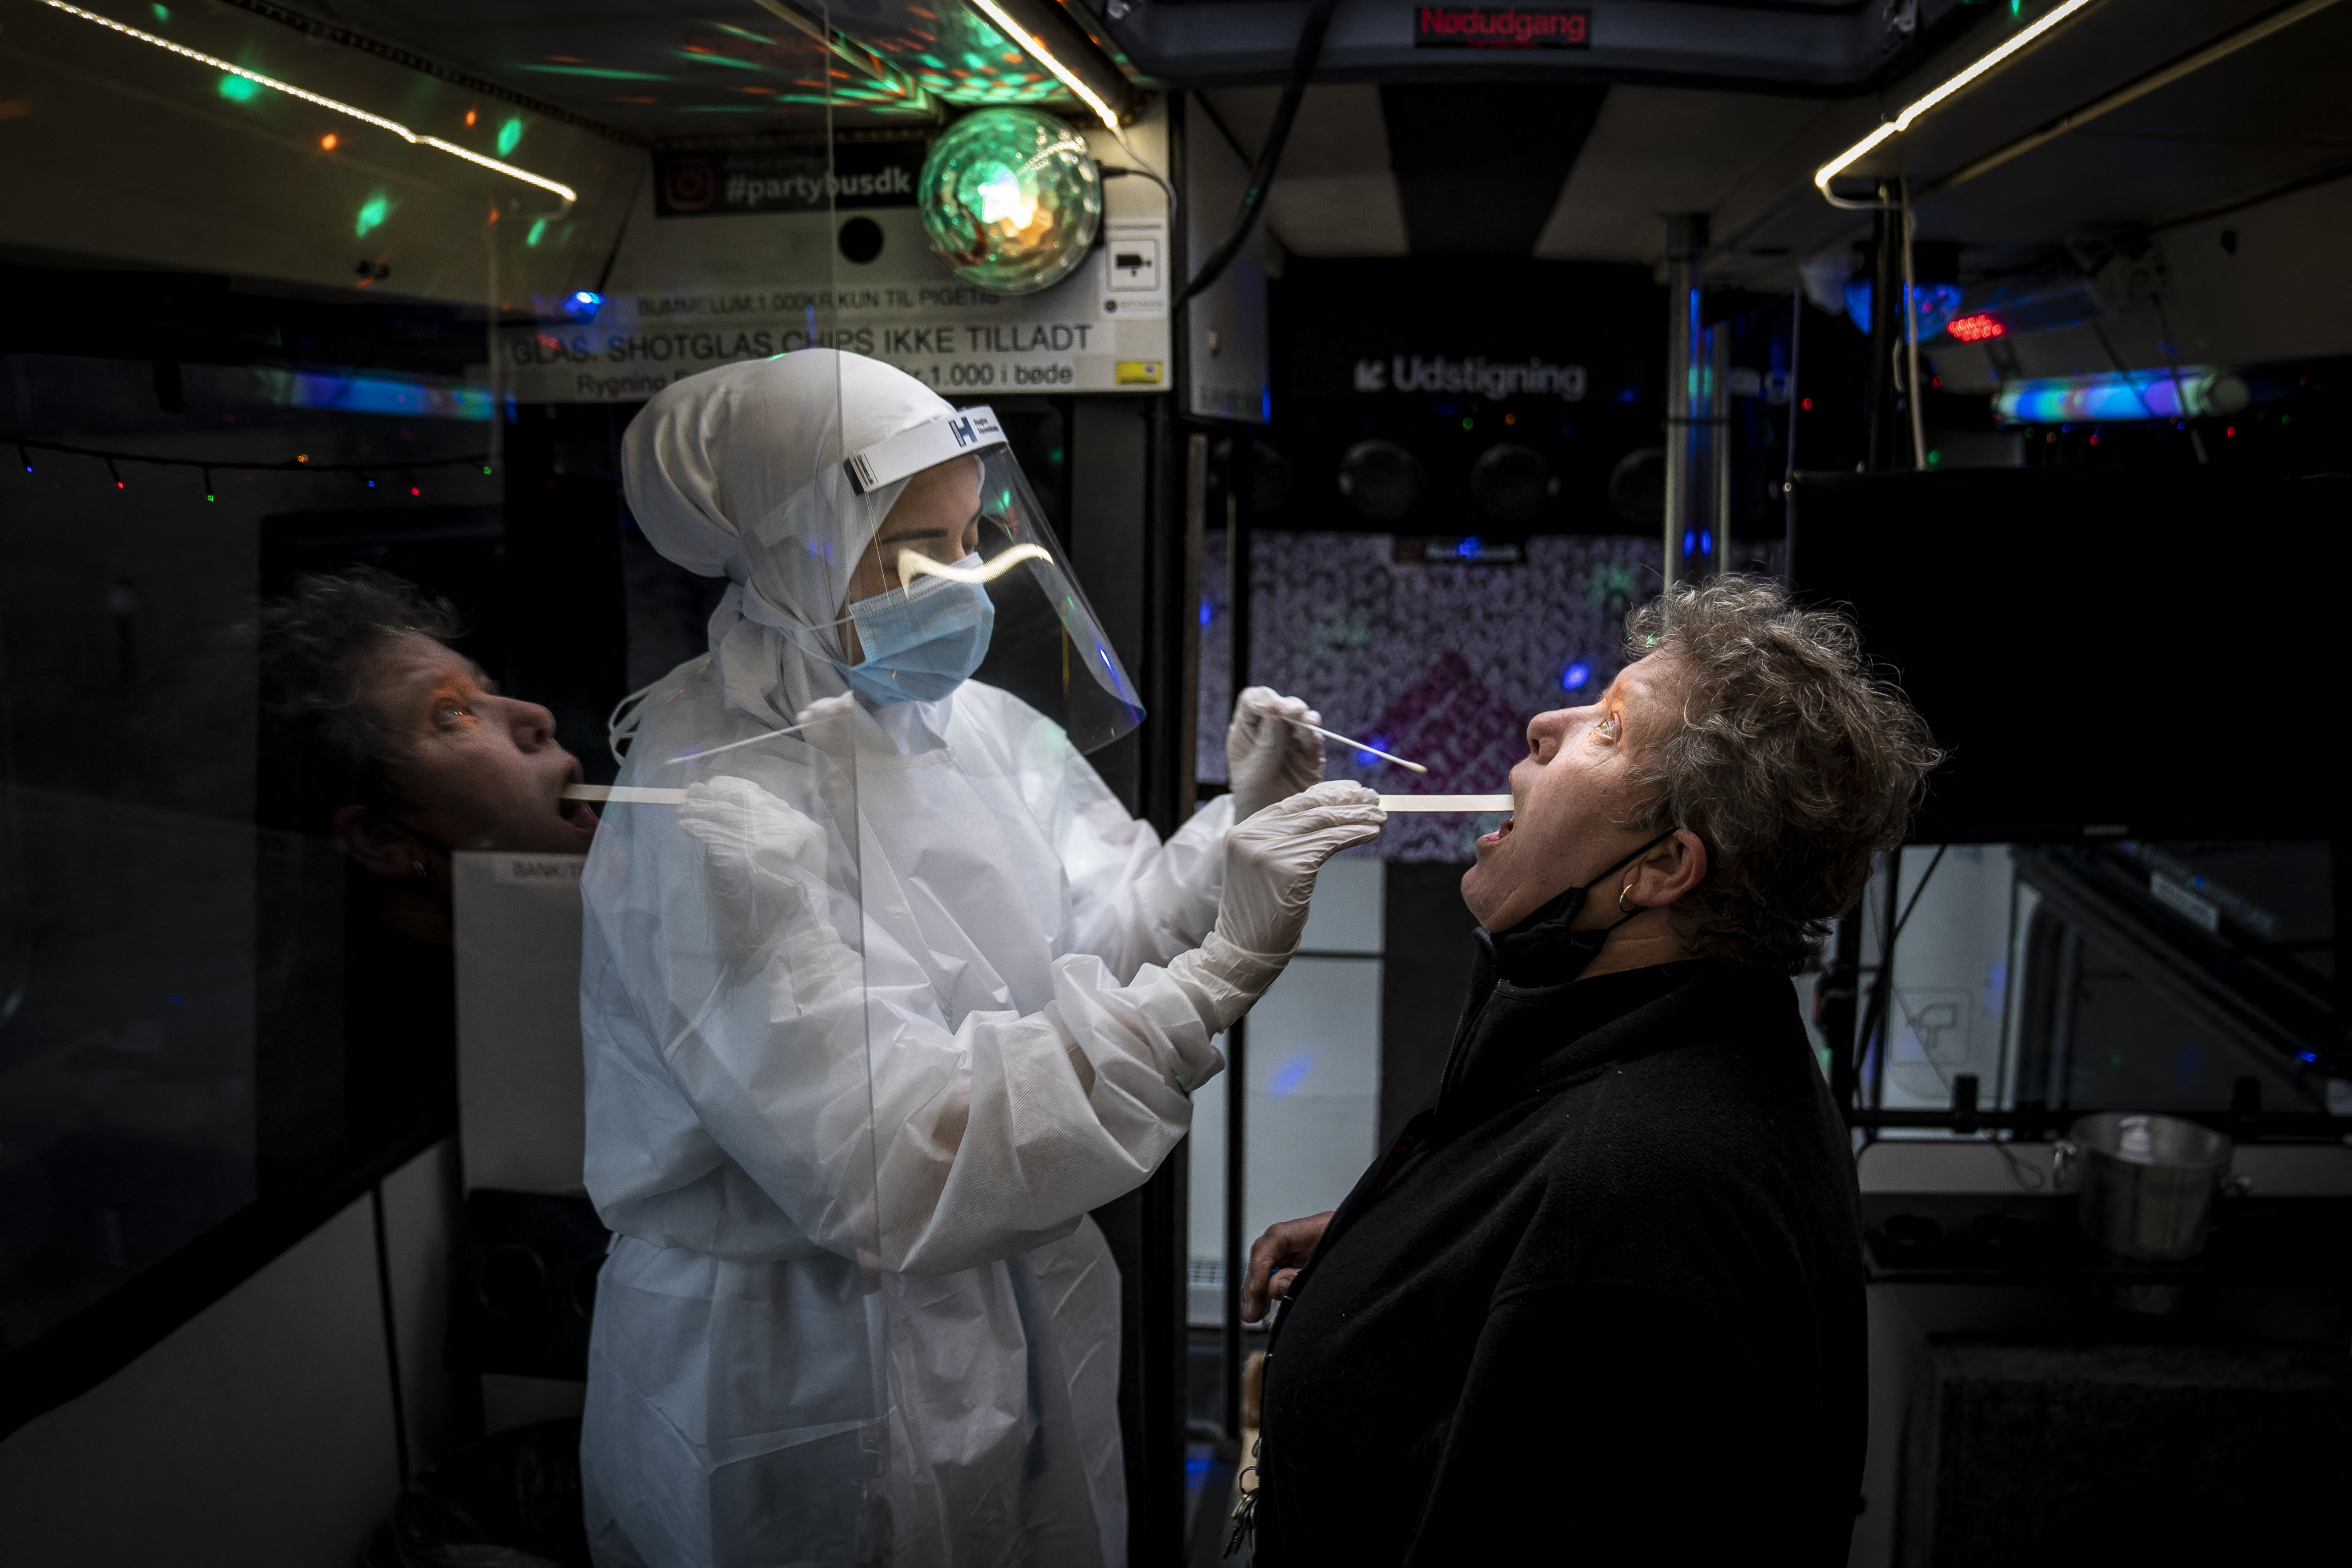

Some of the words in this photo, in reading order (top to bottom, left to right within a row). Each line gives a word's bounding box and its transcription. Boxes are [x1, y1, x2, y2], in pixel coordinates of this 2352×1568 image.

[1421, 7, 1585, 42] Nødudgang
[725, 165, 912, 207] #partybusdk
[885, 289, 915, 307] TIL
[607, 330, 772, 362] SHOTGLAS
[782, 327, 874, 353] CHIPS
[885, 326, 955, 352] IKKE
[963, 325, 1092, 352] TILLADT
[931, 362, 994, 386] 1.000
[1001, 362, 1008, 384] i
[1015, 362, 1073, 385] bøde
[1393, 354, 1585, 400] Udstigning
